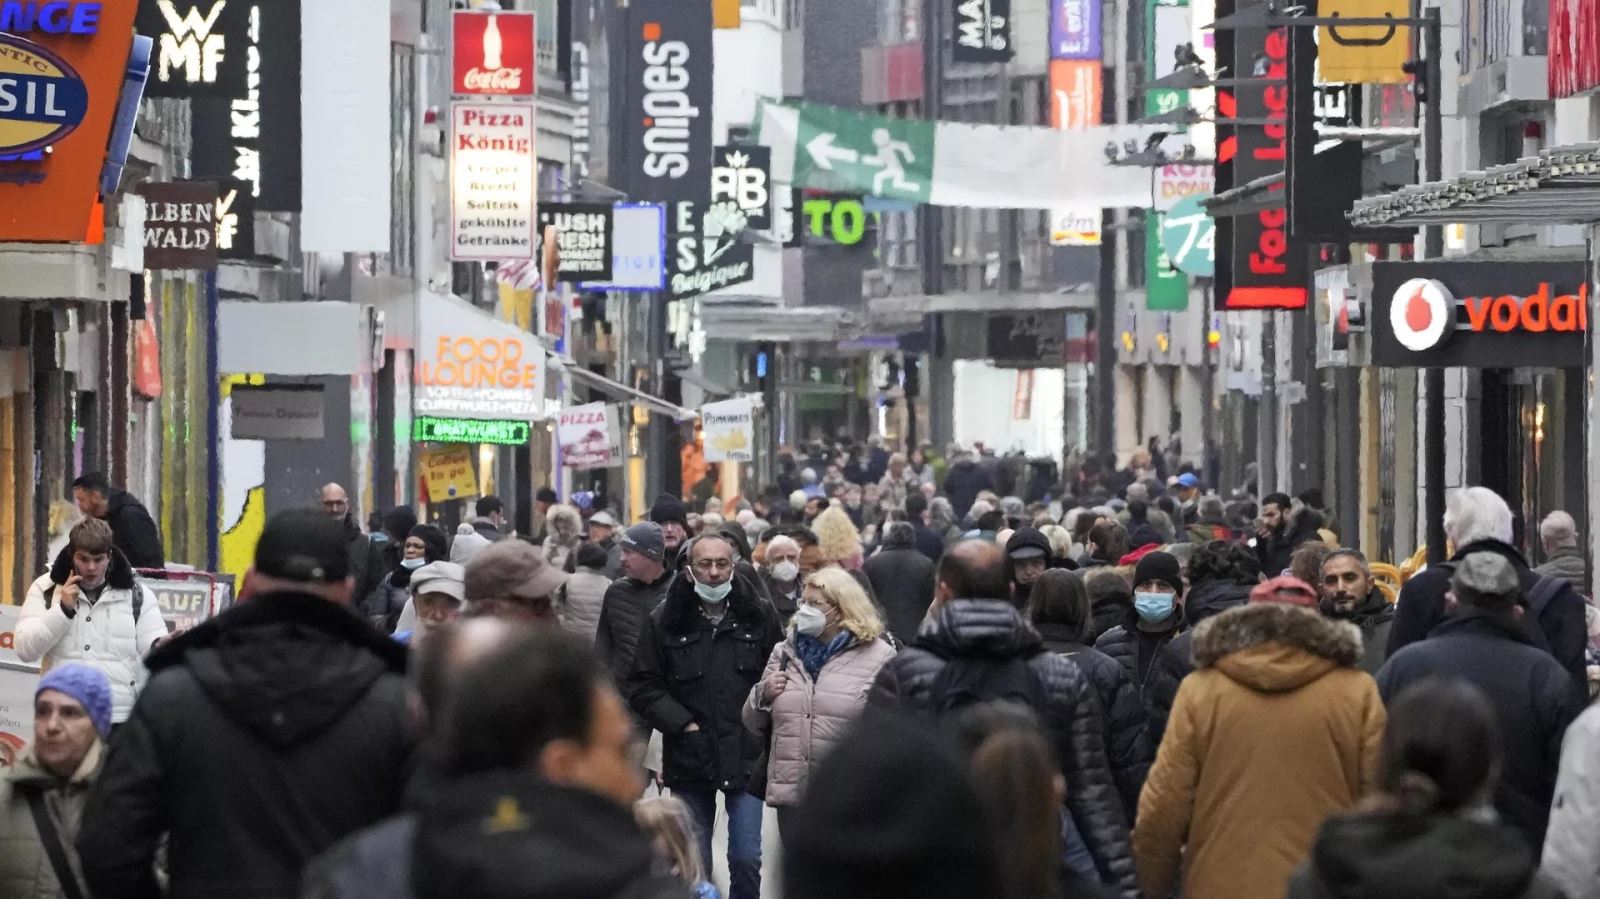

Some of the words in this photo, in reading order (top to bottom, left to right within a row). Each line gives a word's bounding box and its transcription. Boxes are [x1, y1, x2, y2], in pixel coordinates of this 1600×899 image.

[158, 0, 226, 83] WMF
[462, 109, 524, 127] Pizza
[643, 40, 699, 179] snipes
[458, 133, 528, 154] König
[459, 216, 527, 229] gekühlte
[457, 233, 529, 247] Getränke
[436, 335, 524, 363] FOOD
[422, 360, 537, 389] LOUNGE
[560, 411, 605, 426] PIZZA
